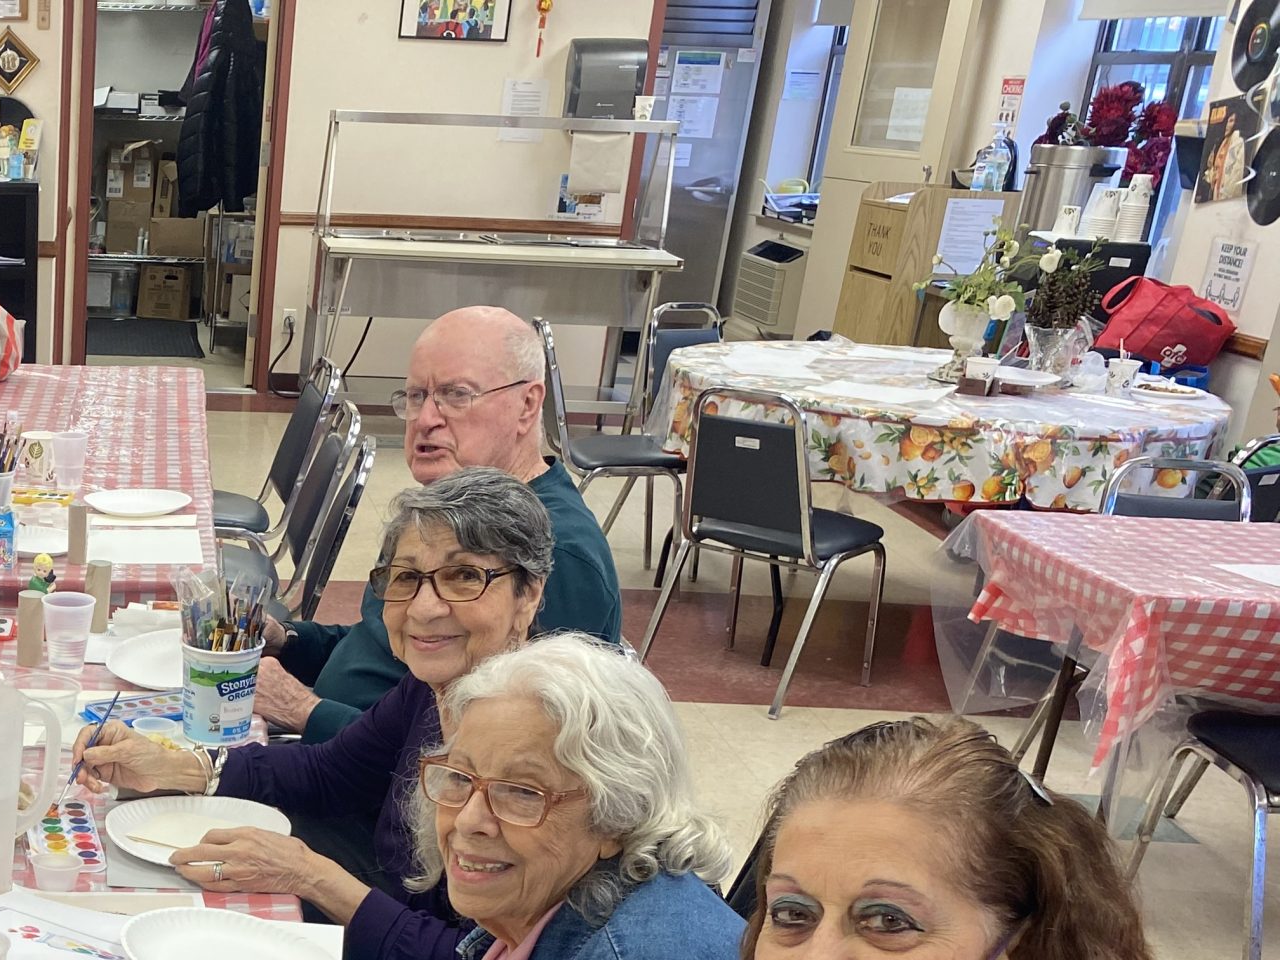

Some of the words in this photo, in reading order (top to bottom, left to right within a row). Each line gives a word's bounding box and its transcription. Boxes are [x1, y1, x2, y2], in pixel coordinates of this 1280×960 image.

[868, 222, 892, 240] THANK
[868, 241, 882, 256] YOU
[1221, 243, 1233, 253] KEEP
[1234, 246, 1248, 257] YOUR
